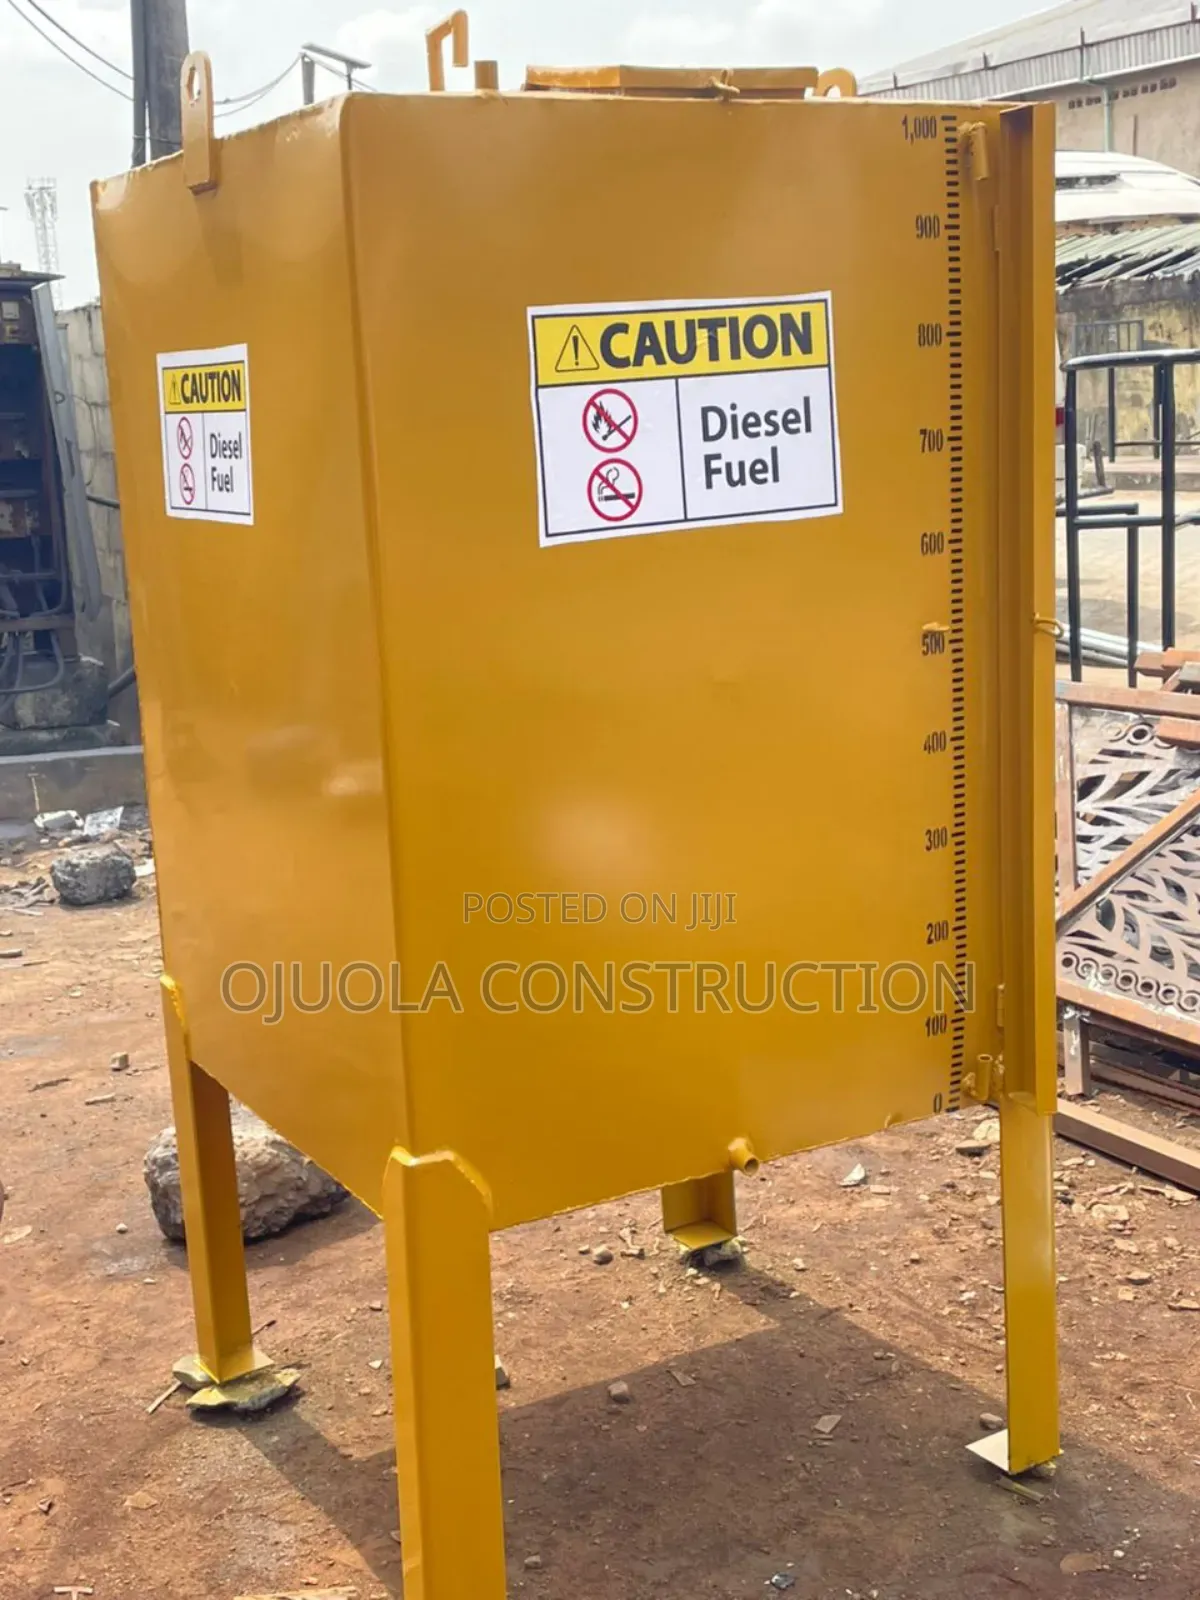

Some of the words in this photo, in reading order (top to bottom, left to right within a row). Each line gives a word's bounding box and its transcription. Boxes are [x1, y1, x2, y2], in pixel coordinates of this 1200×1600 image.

[901, 115, 938, 144] 1,000
[915, 215, 940, 239] 900
[601, 311, 813, 369] CAUTION
[917, 323, 942, 348] 800
[180, 369, 242, 405] CAUTION
[700, 396, 813, 443] Diesel
[209, 432, 243, 461] Diesel
[919, 429, 944, 453] 700
[210, 466, 234, 493] Fuel
[703, 446, 780, 490] Fuel
[920, 532, 945, 555] 600
[921, 632, 945, 655] 500
[923, 731, 947, 754] 400
[925, 827, 948, 851] 300
[926, 920, 949, 943] 200
[925, 1013, 948, 1037] 100
[932, 1092, 944, 1113] 0
